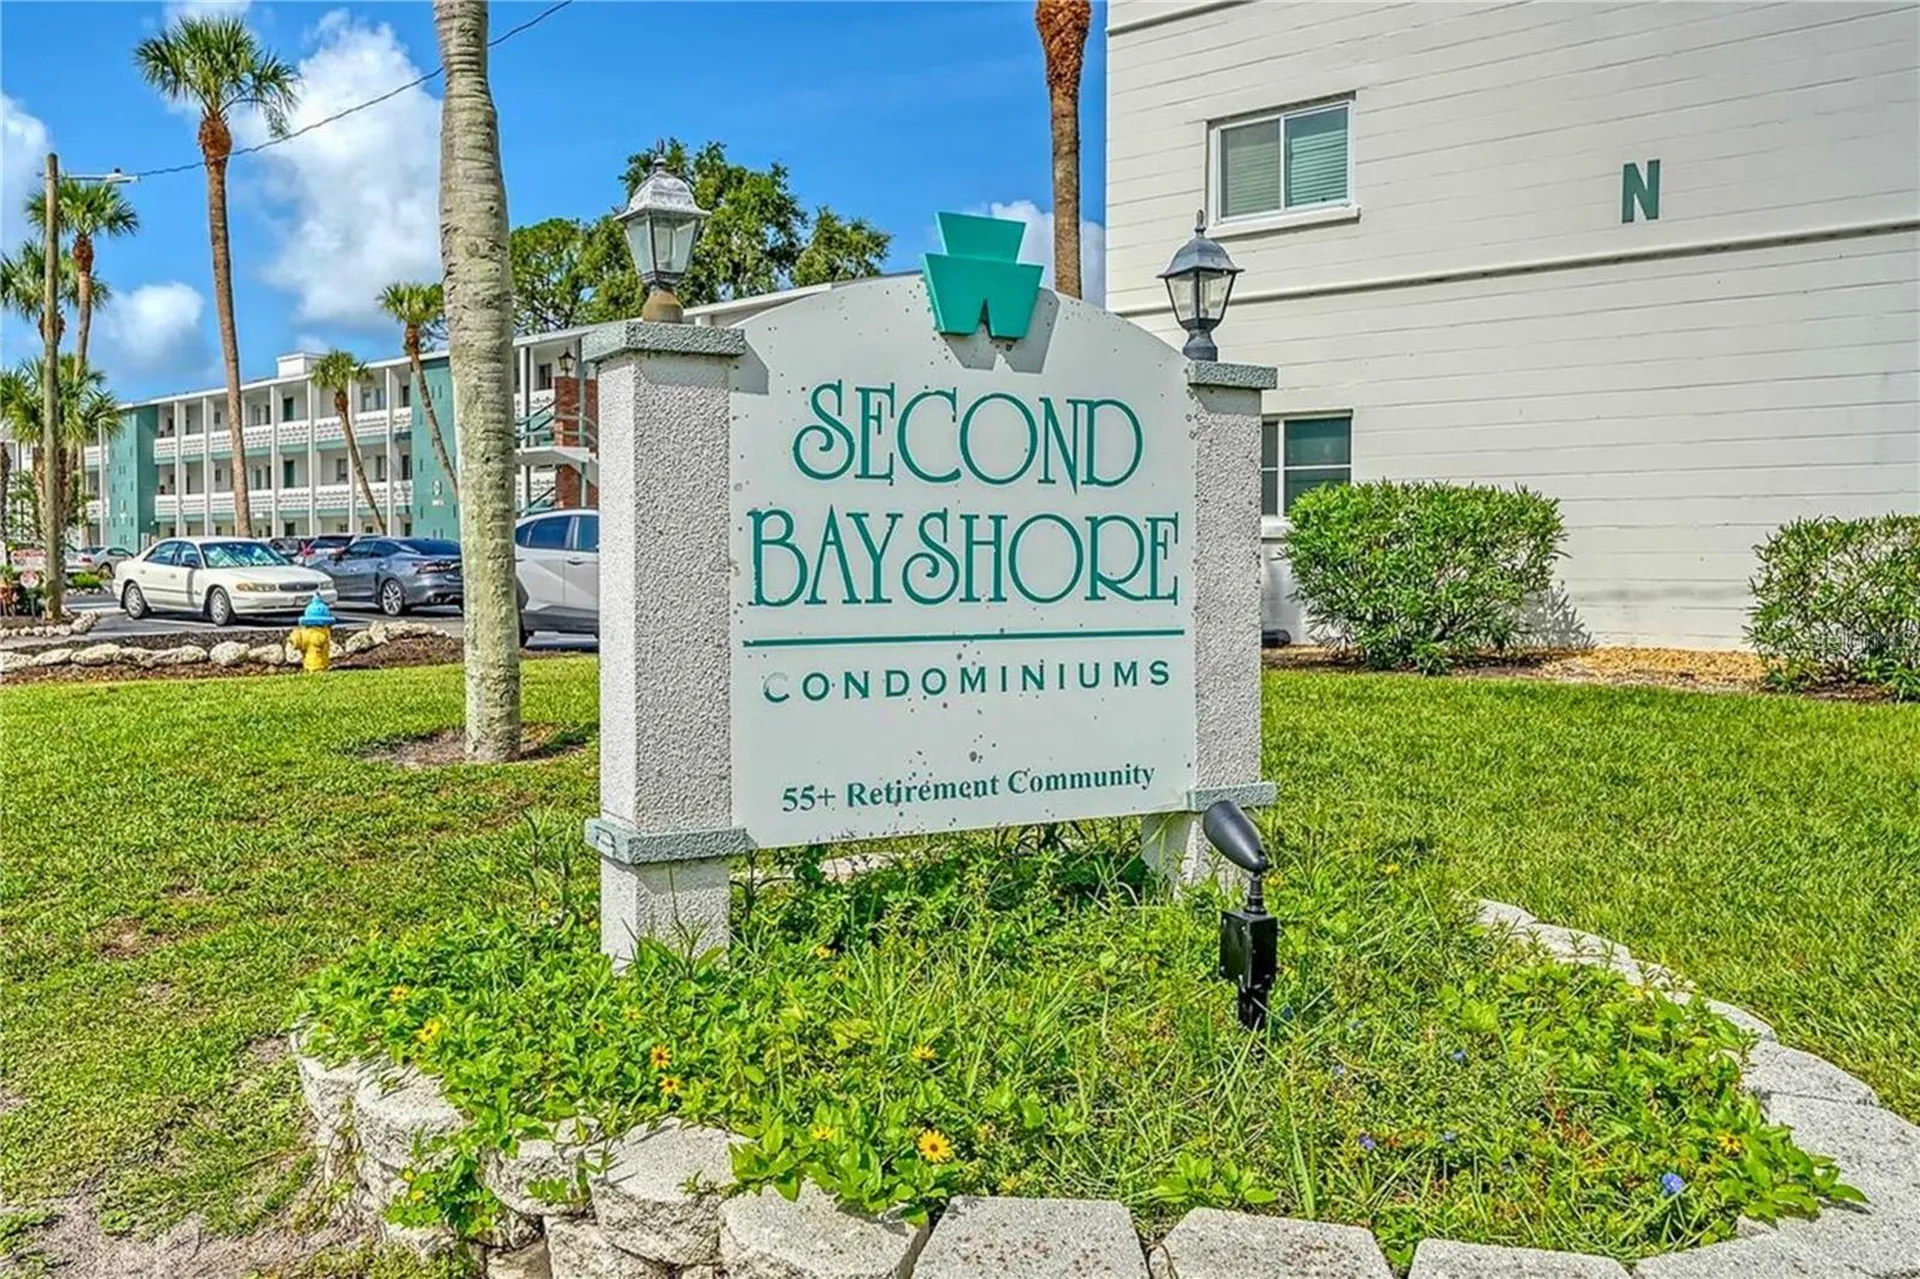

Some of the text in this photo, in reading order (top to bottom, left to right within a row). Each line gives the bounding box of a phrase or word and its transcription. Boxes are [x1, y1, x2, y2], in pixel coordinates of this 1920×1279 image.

[1621, 158, 1661, 224] N
[792, 379, 1143, 494] SECOND
[746, 505, 1179, 608] BAYSHORE
[762, 660, 1170, 704] CONDOMINIUMS
[782, 764, 1155, 811] 55+ Retirement Community
